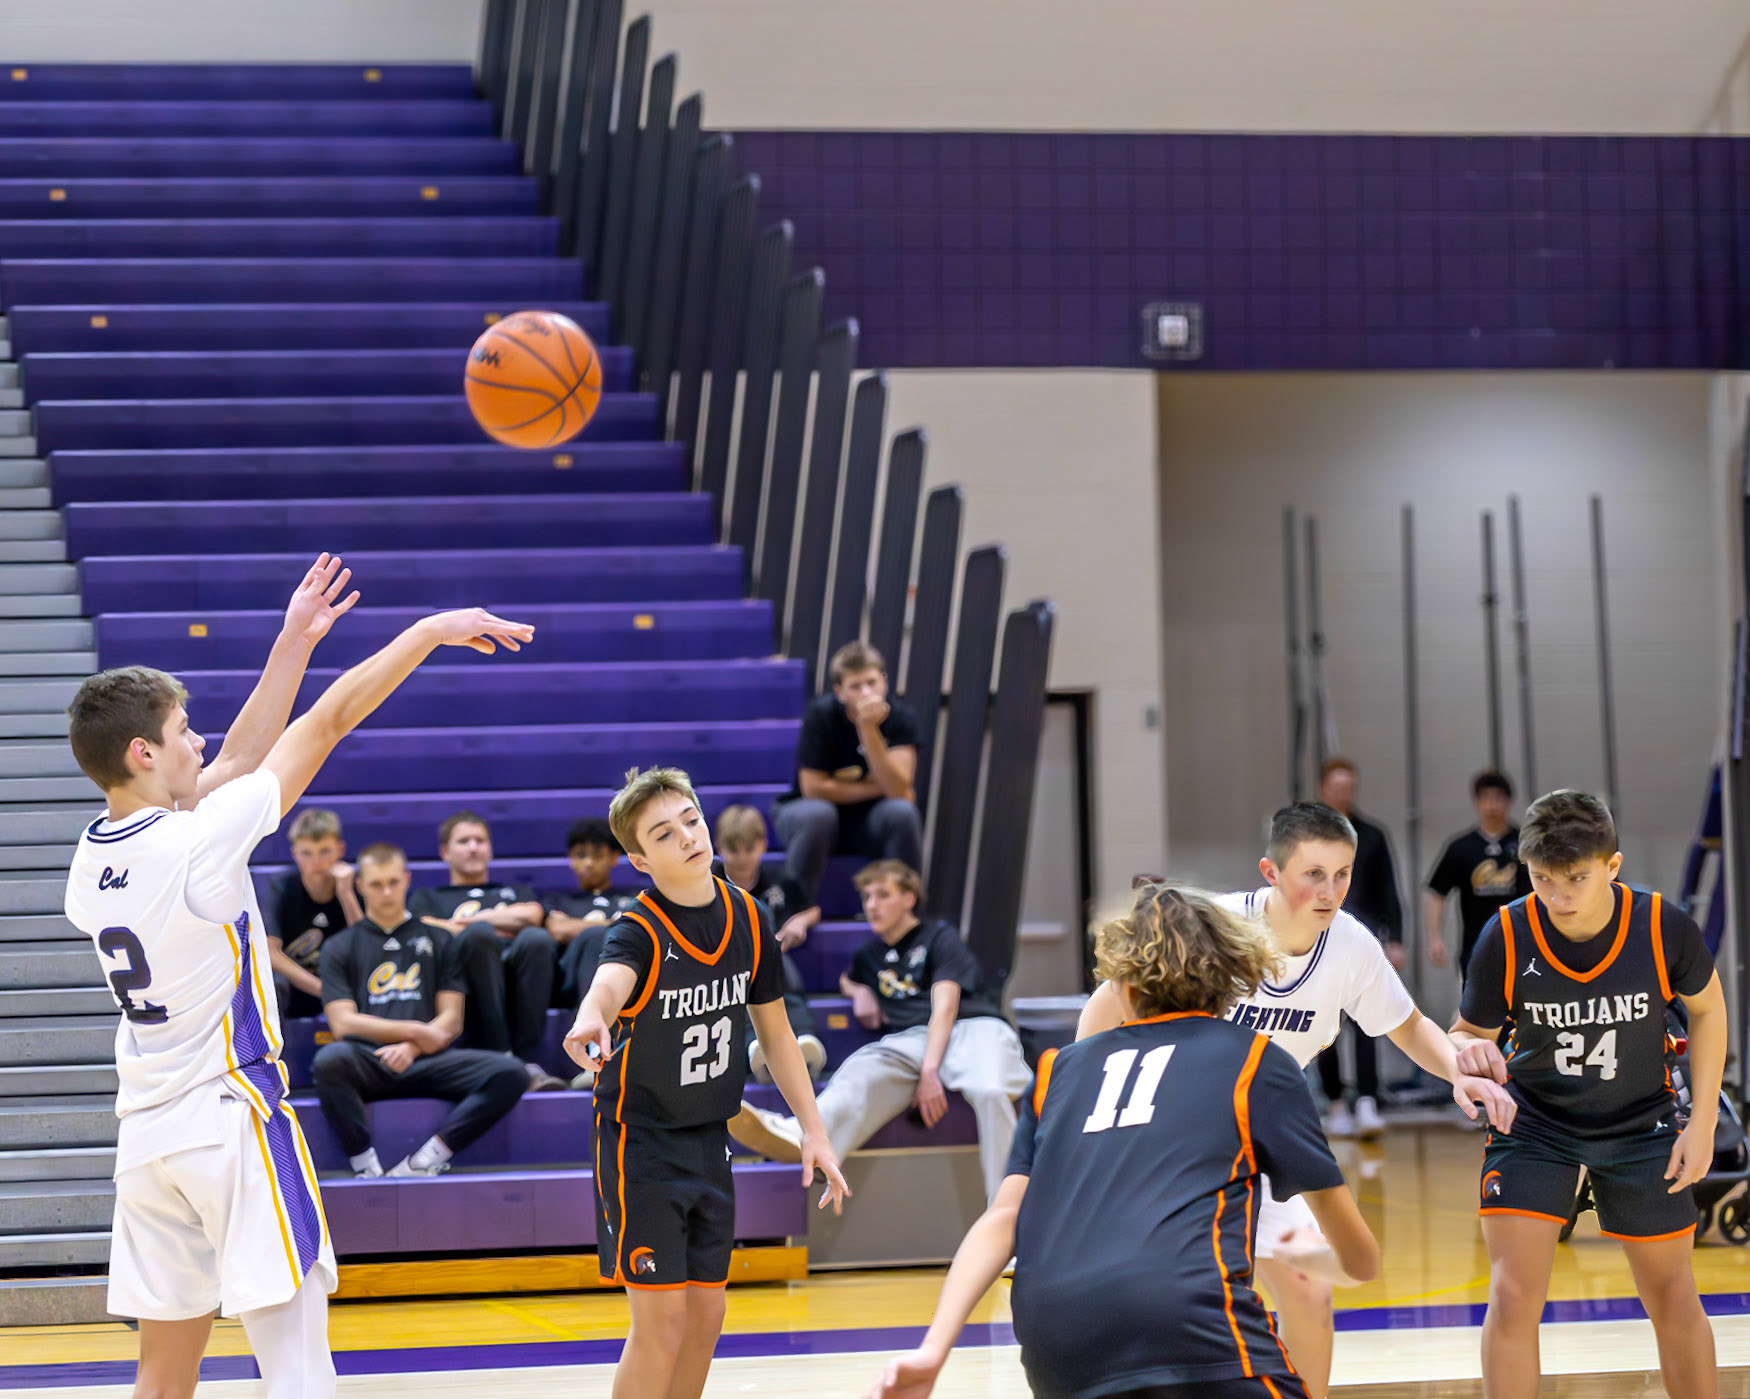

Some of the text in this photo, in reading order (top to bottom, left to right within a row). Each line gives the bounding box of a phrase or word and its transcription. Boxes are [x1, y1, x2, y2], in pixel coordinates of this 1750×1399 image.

[99, 866, 129, 891] Cal
[99, 926, 169, 1025] 2
[367, 961, 422, 996] Cal
[658, 970, 752, 1021] TROJAN
[1223, 1003, 1317, 1033] IGHTING
[1523, 991, 1650, 1029] TROJANS
[679, 1015, 733, 1087] 23
[1554, 1029, 1619, 1081] 24
[1082, 1044, 1177, 1134] 11
